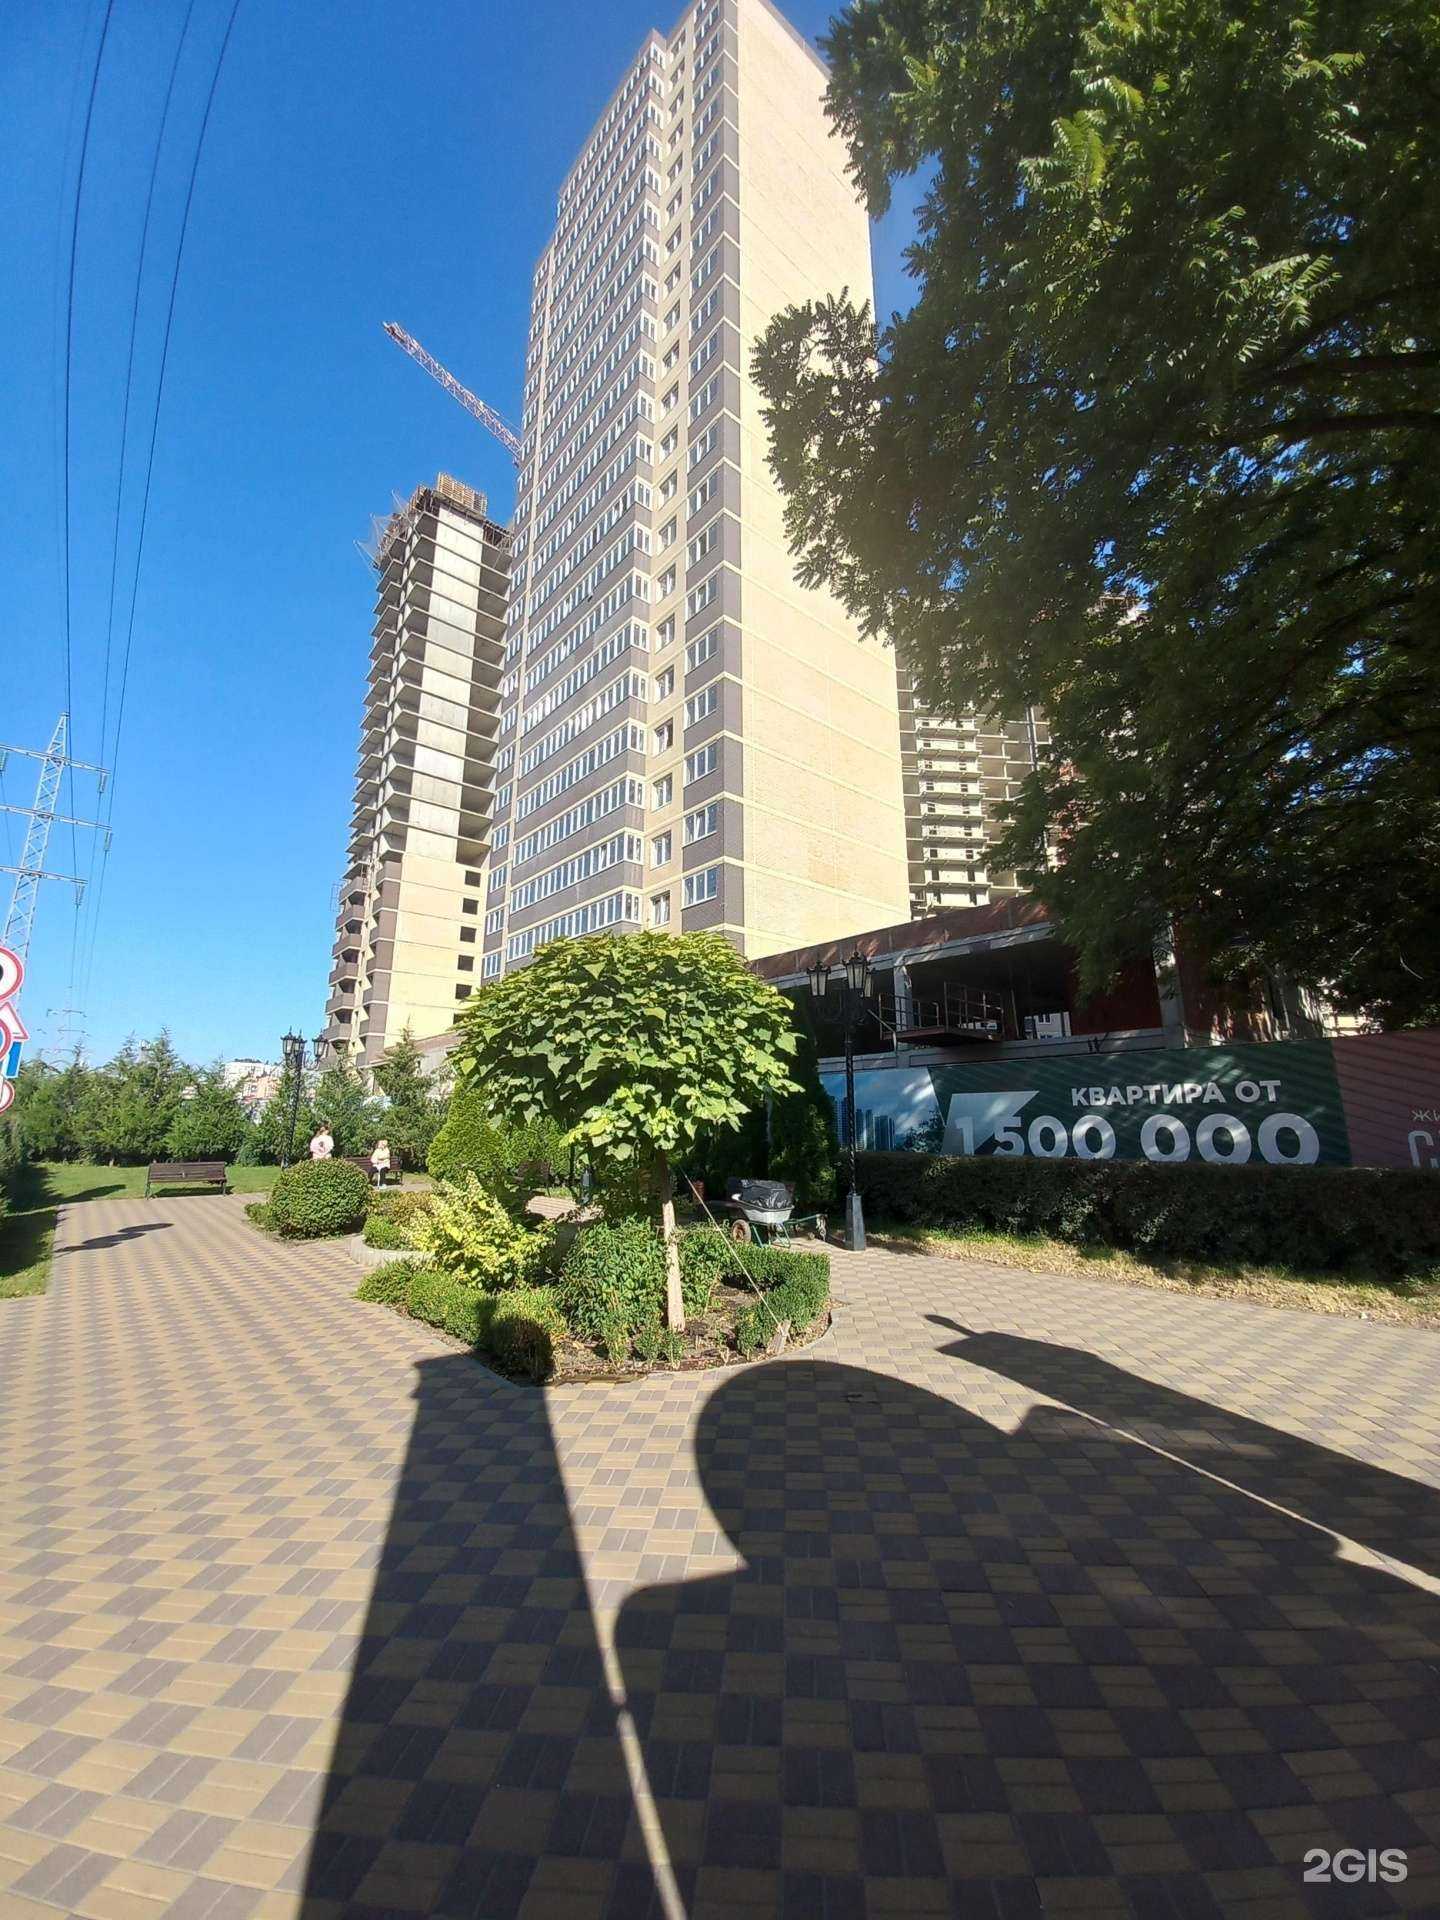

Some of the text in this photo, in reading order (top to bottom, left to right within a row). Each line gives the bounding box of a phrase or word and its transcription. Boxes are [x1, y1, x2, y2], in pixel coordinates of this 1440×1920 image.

[1071, 1079, 1281, 1107] КВАРТИРА ОТ
[1140, 1113, 1321, 1165] 000
